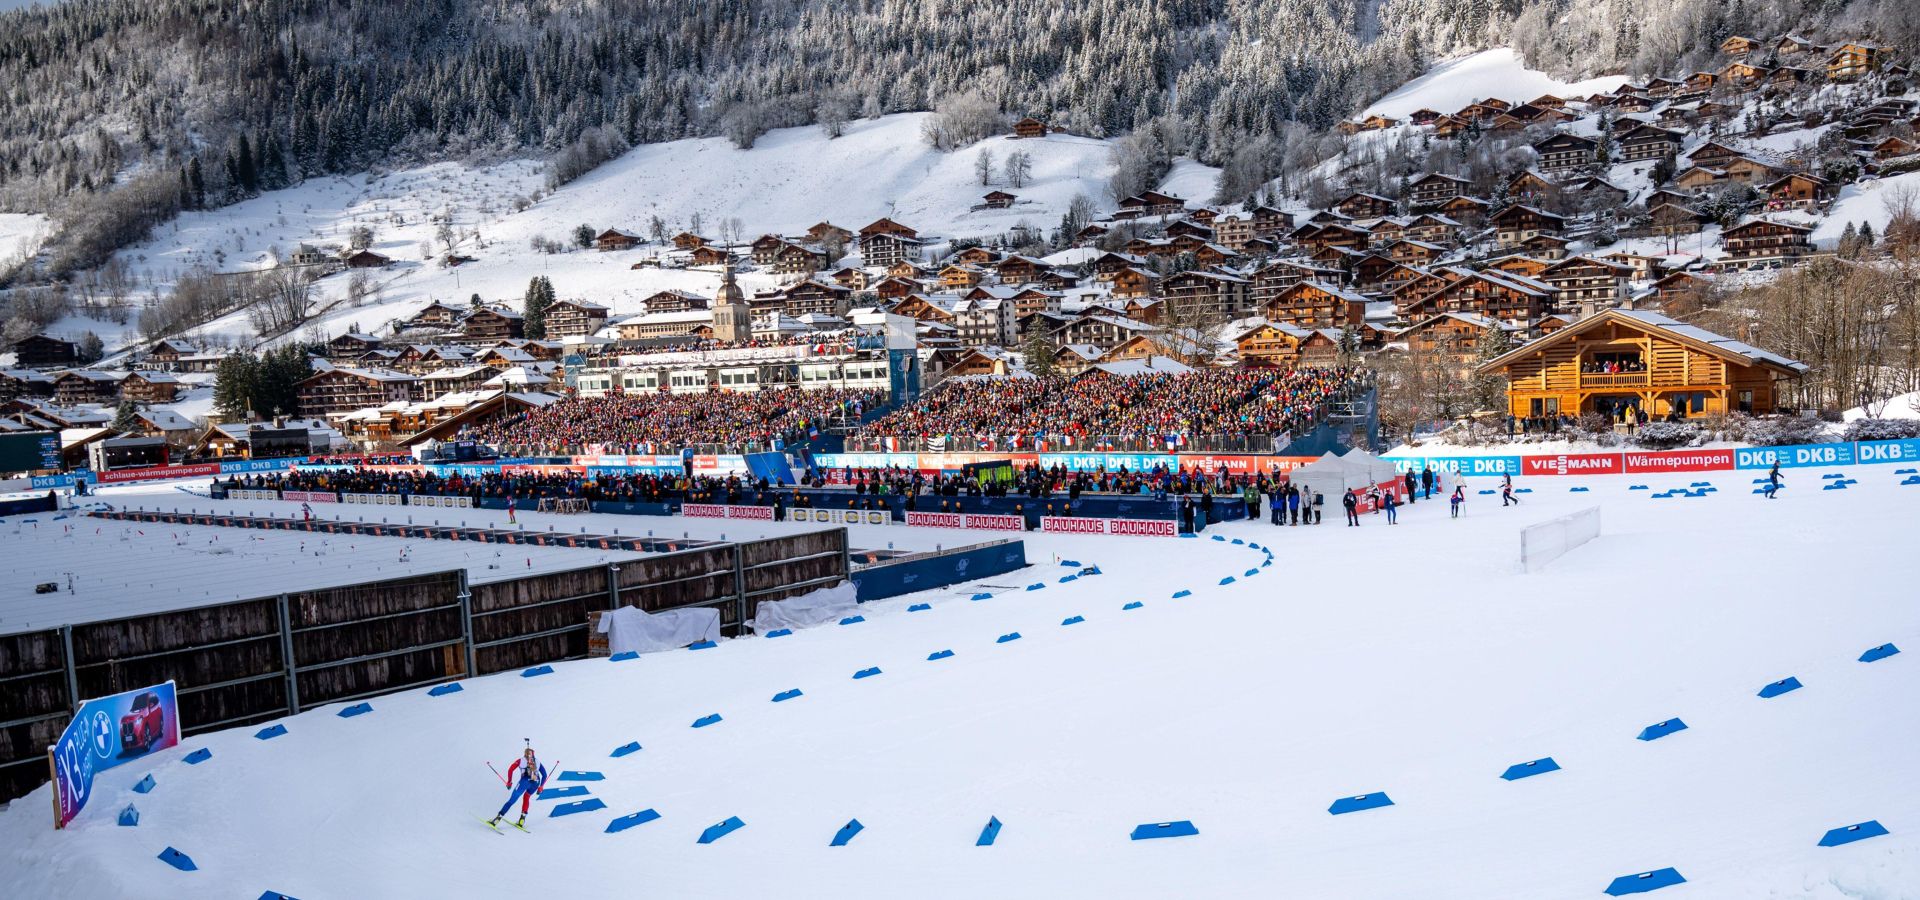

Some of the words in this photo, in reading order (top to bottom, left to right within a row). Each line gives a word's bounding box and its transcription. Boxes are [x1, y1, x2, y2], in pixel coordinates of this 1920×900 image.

[1739, 451, 1776, 466] DKB
[1796, 448, 1836, 464] DKB
[1860, 444, 1902, 460] DKB
[222, 464, 242, 472] DKB
[1074, 458, 1096, 468] DKB
[1108, 458, 1133, 469] DKB
[1186, 456, 1247, 473] VIESSMANN
[1430, 460, 1460, 472] DKB
[1474, 460, 1506, 472] DKB
[1530, 456, 1612, 475] VIESSMANN
[1628, 454, 1730, 469] Wärmepumpen
[104, 466, 212, 480] schlaue-wärmepumpe.com
[463, 468, 477, 476] DKB
[34, 478, 56, 487] DKB
[684, 506, 724, 517] BAUHAUS
[729, 507, 772, 518] BAUHAUS
[908, 514, 960, 526] BAUHAUS
[966, 516, 1020, 529] BAUHAUS
[1044, 520, 1103, 532] BAUHAUS
[1111, 522, 1174, 535] BAUHAUS
[60, 738, 84, 814] X3
